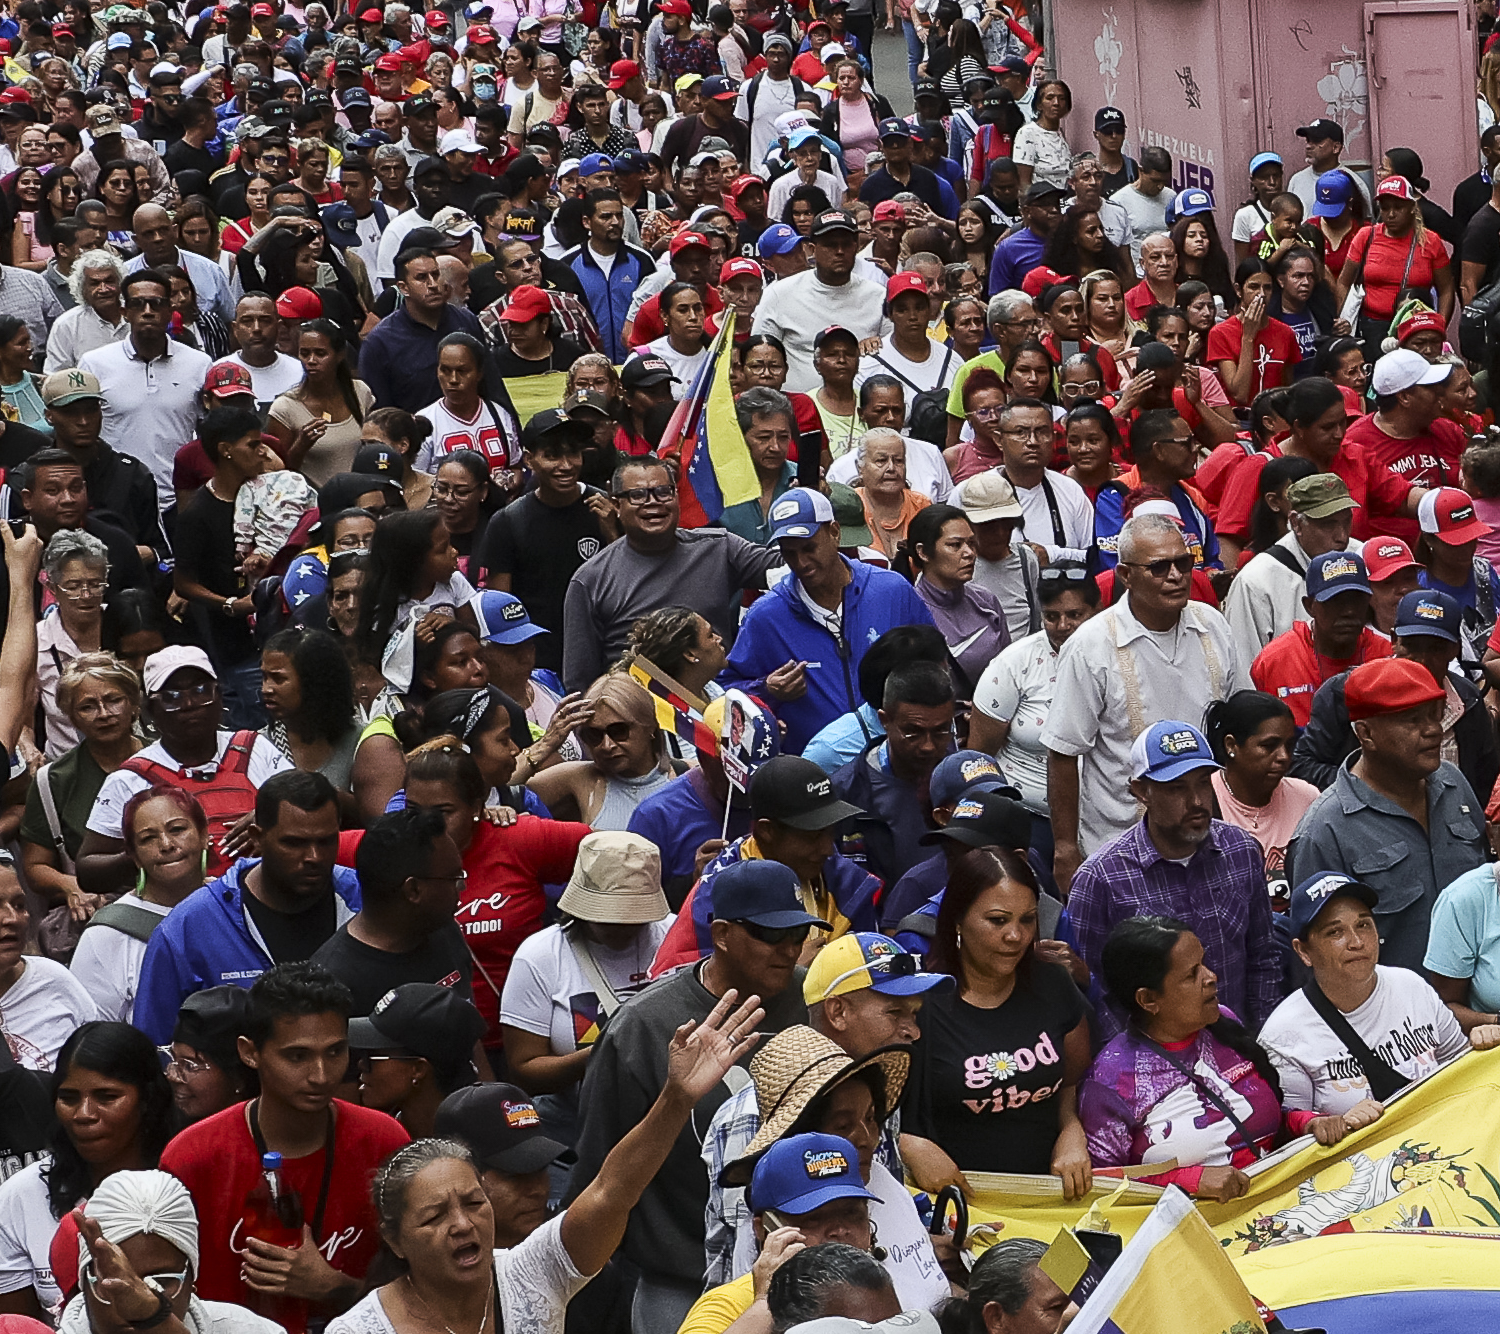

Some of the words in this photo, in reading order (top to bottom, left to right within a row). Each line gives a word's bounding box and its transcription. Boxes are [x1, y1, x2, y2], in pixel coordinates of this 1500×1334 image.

[1138, 126, 1215, 166] VENEZUELA
[1172, 160, 1215, 193] JER
[579, 540, 597, 557] WB
[465, 919, 502, 935] TODO!
[804, 1150, 834, 1164] Sucre
